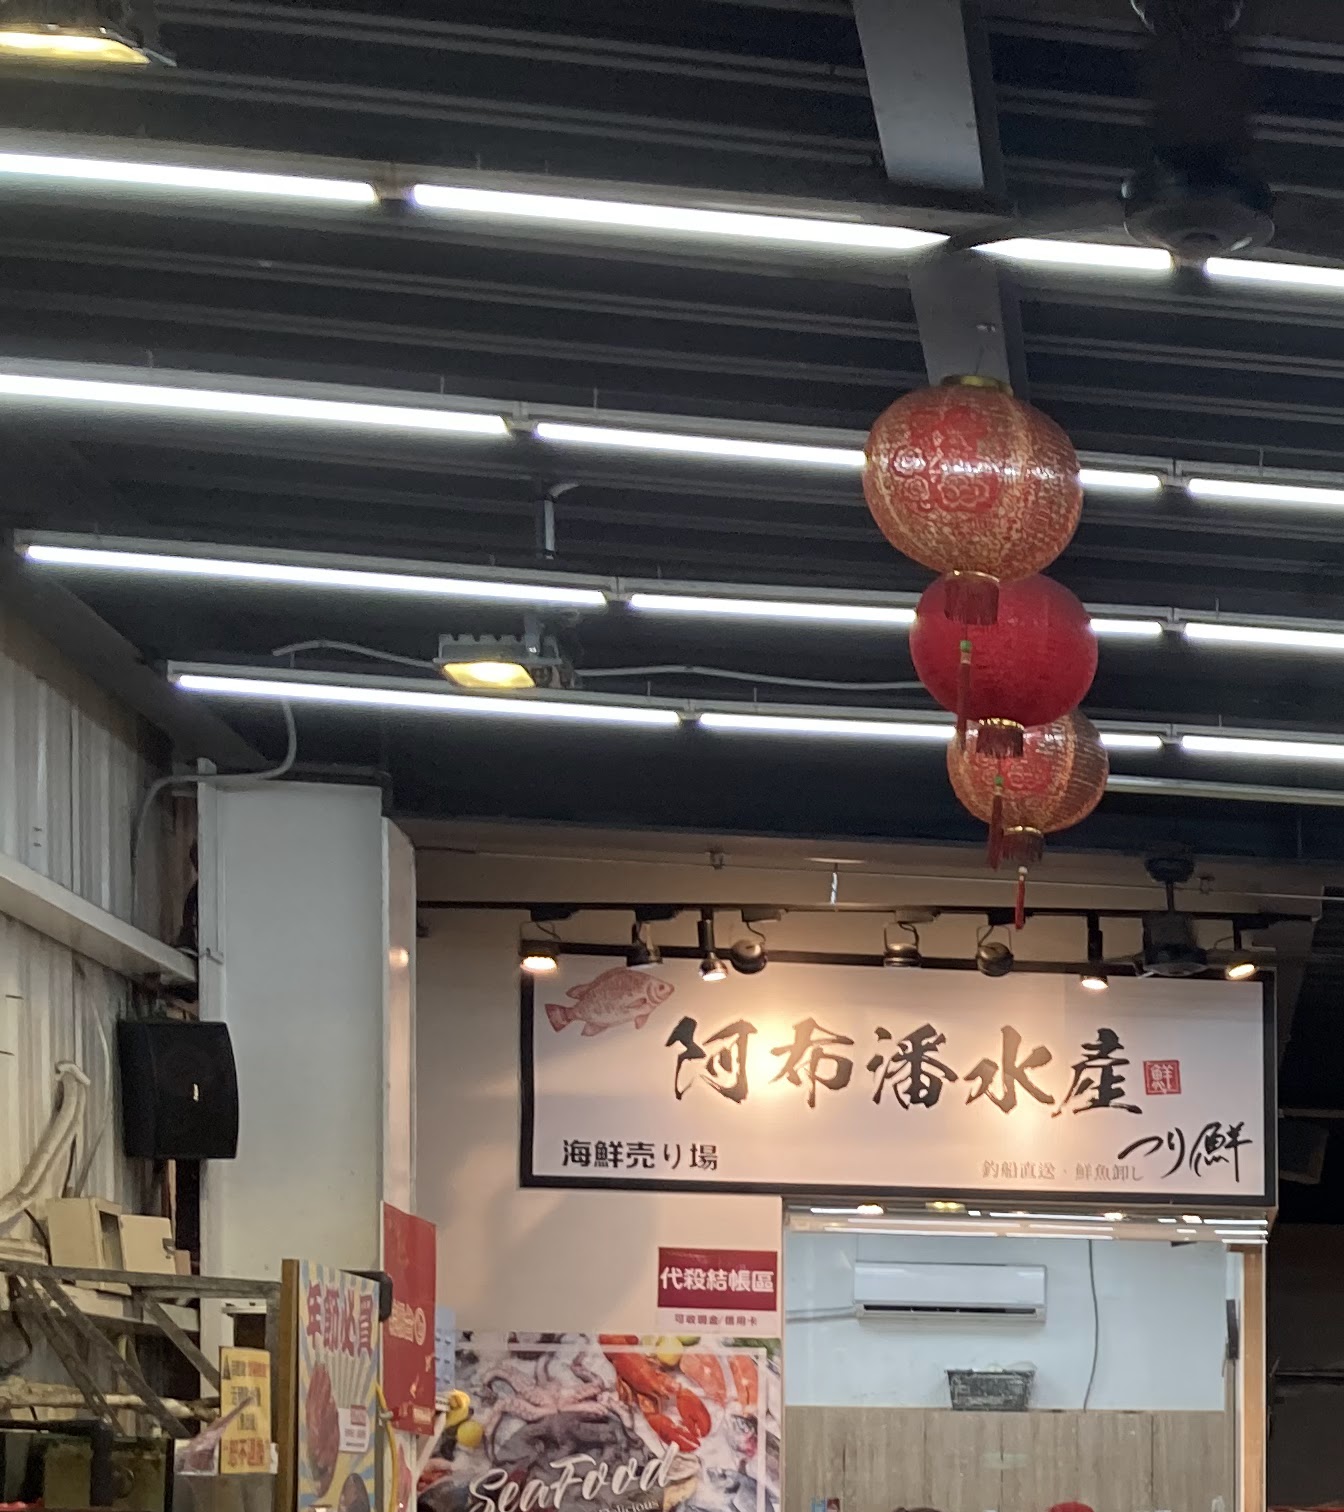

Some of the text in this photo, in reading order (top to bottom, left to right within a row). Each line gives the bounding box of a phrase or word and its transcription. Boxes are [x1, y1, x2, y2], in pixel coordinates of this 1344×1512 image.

[561, 1138, 719, 1173] 海鮮売り場
[659, 1266, 775, 1293] 代殺結帳區
